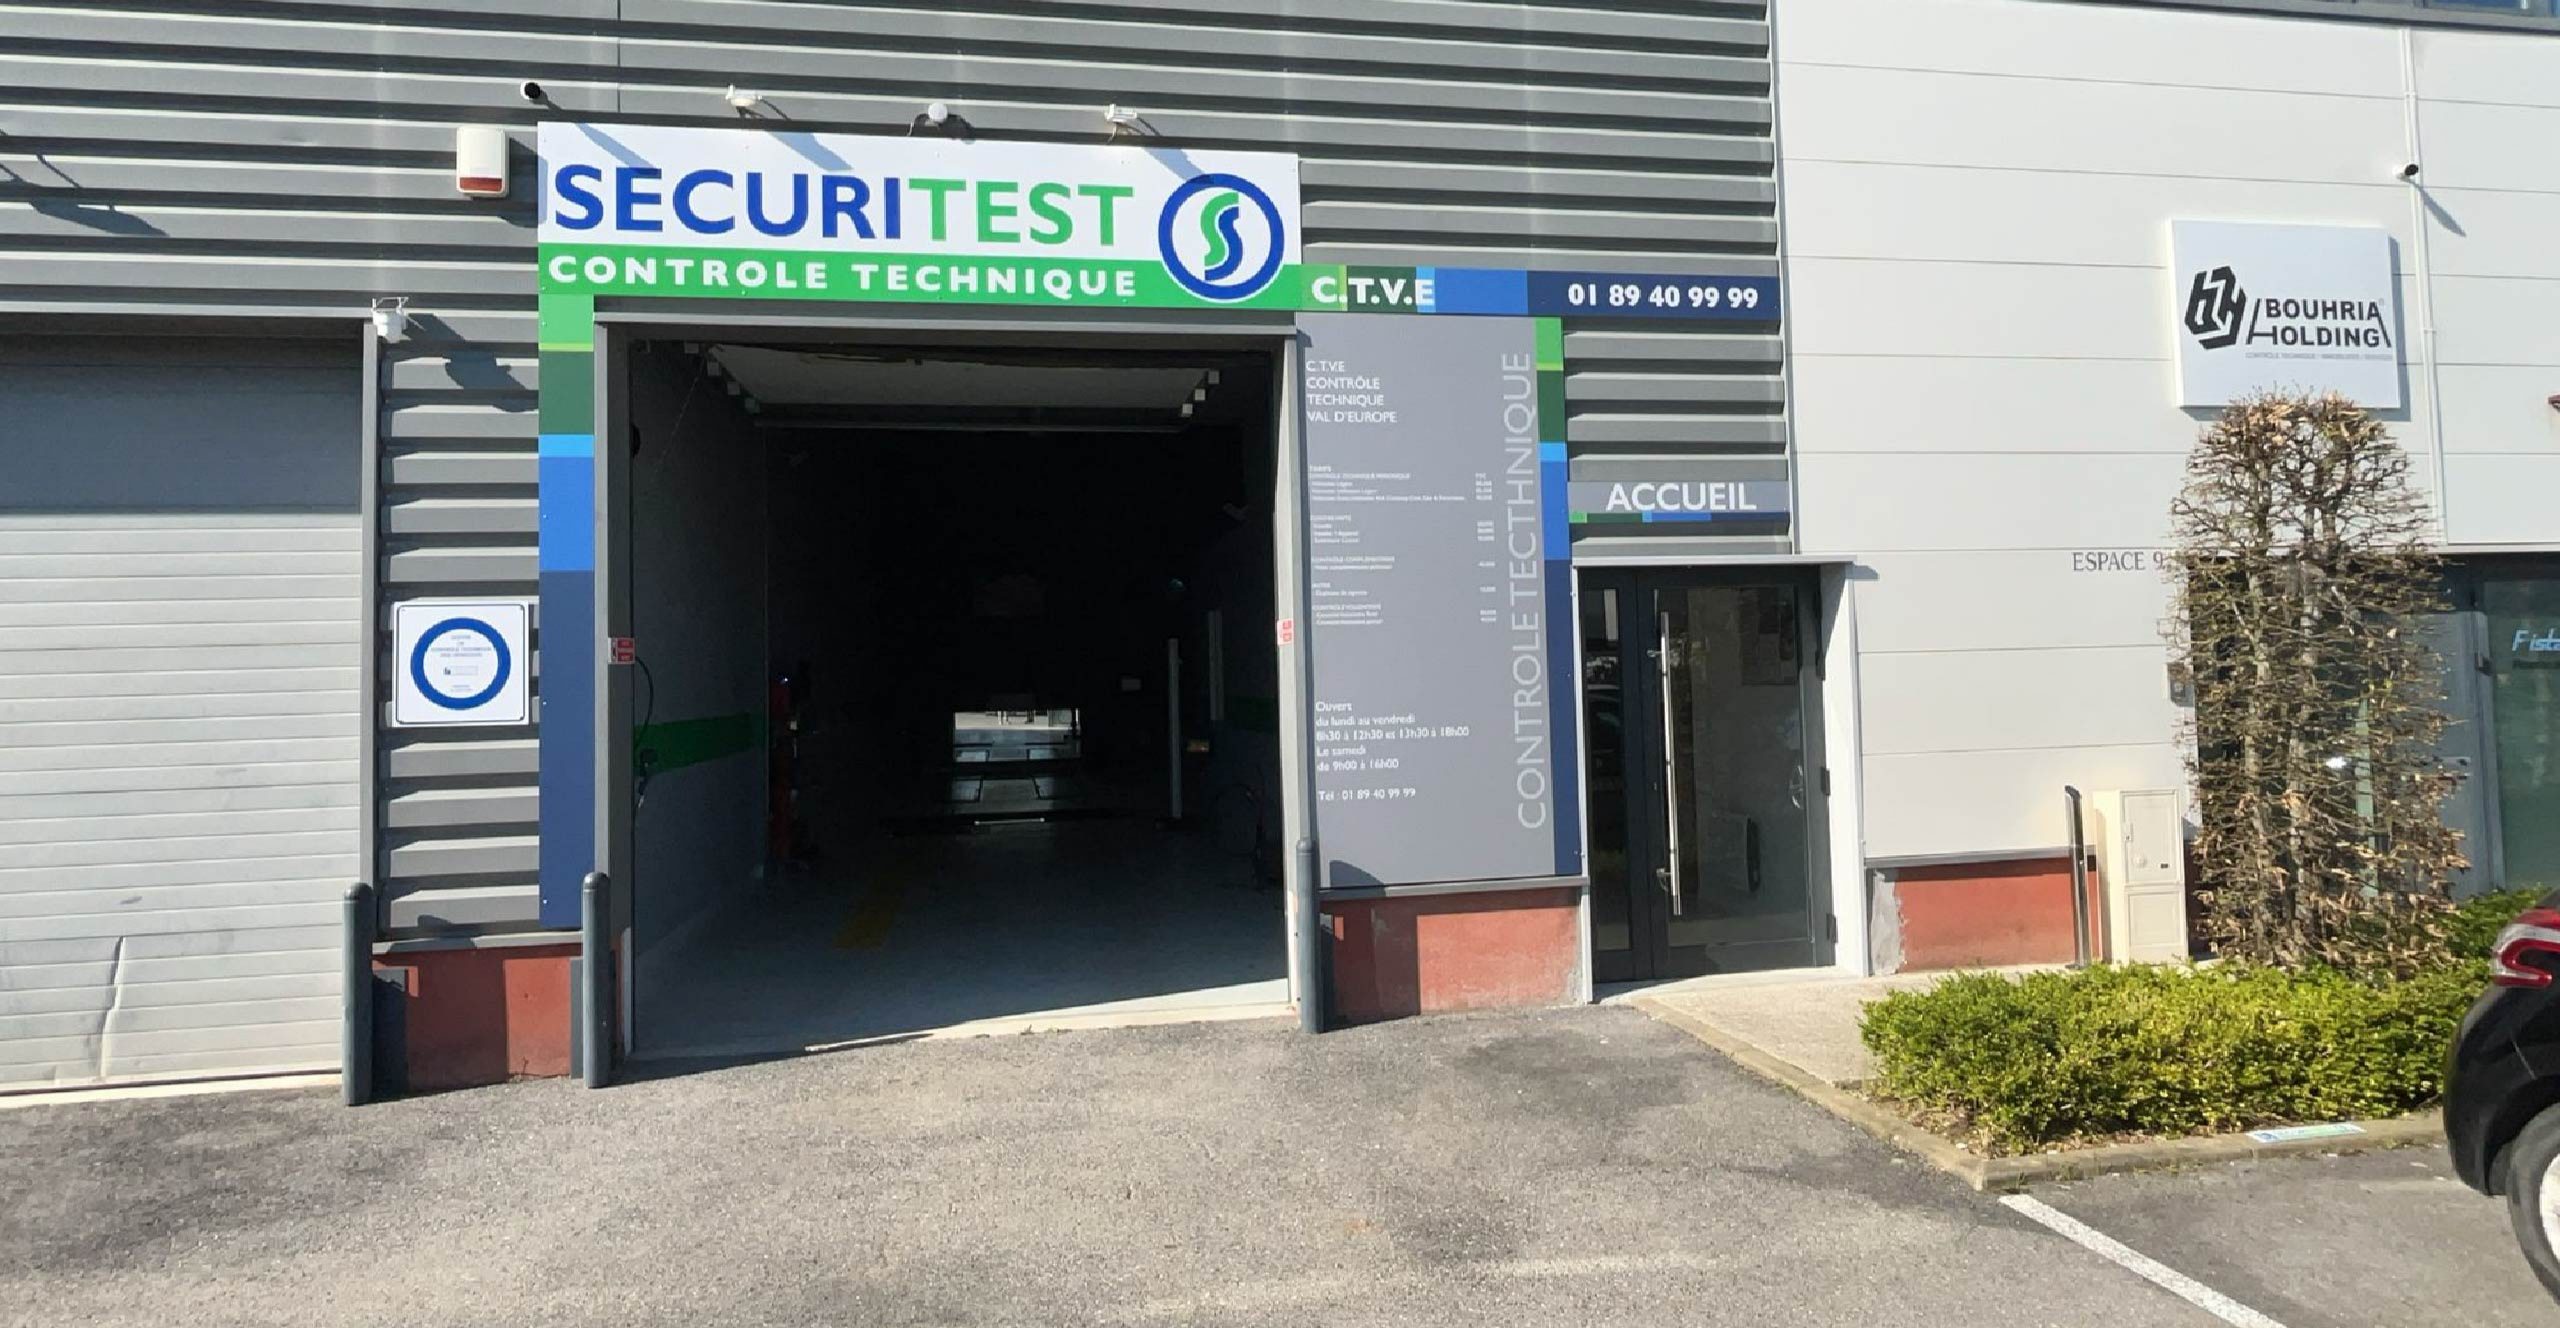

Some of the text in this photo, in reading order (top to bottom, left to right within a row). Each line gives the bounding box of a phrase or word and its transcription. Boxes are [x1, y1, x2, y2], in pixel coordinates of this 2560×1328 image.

[552, 163, 1134, 246] SECURITEST
[548, 255, 1138, 300] CONTROLE TECHNIQUE
[1312, 275, 1435, 306] C.T.V.E
[1568, 283, 1759, 309] 01 89 40 99 99
[2265, 298, 2381, 322] BOUHRIA
[2246, 325, 2381, 348] HOLDING
[1306, 394, 1384, 407] TECHNIQUE
[1306, 411, 1331, 422] VAL
[1606, 481, 1758, 512] ACCUEIL
[2073, 551, 2146, 571] ESPACE
[1315, 701, 1353, 712] Ouvert
[1316, 713, 1416, 727] du lundi au vendredi
[1511, 612, 1547, 829] CONTROLE
[1353, 728, 1384, 741] 12h30
[1316, 744, 1367, 757] Le samedi
[1317, 760, 1330, 772] de
[1332, 760, 1358, 771] 9h00
[1369, 758, 1399, 769] 16h00
[1341, 789, 1353, 801] 01
[1356, 788, 1370, 800] 89
[1373, 788, 1386, 800] 40
[1387, 787, 1400, 799] 99
[1402, 786, 1416, 797] 99
